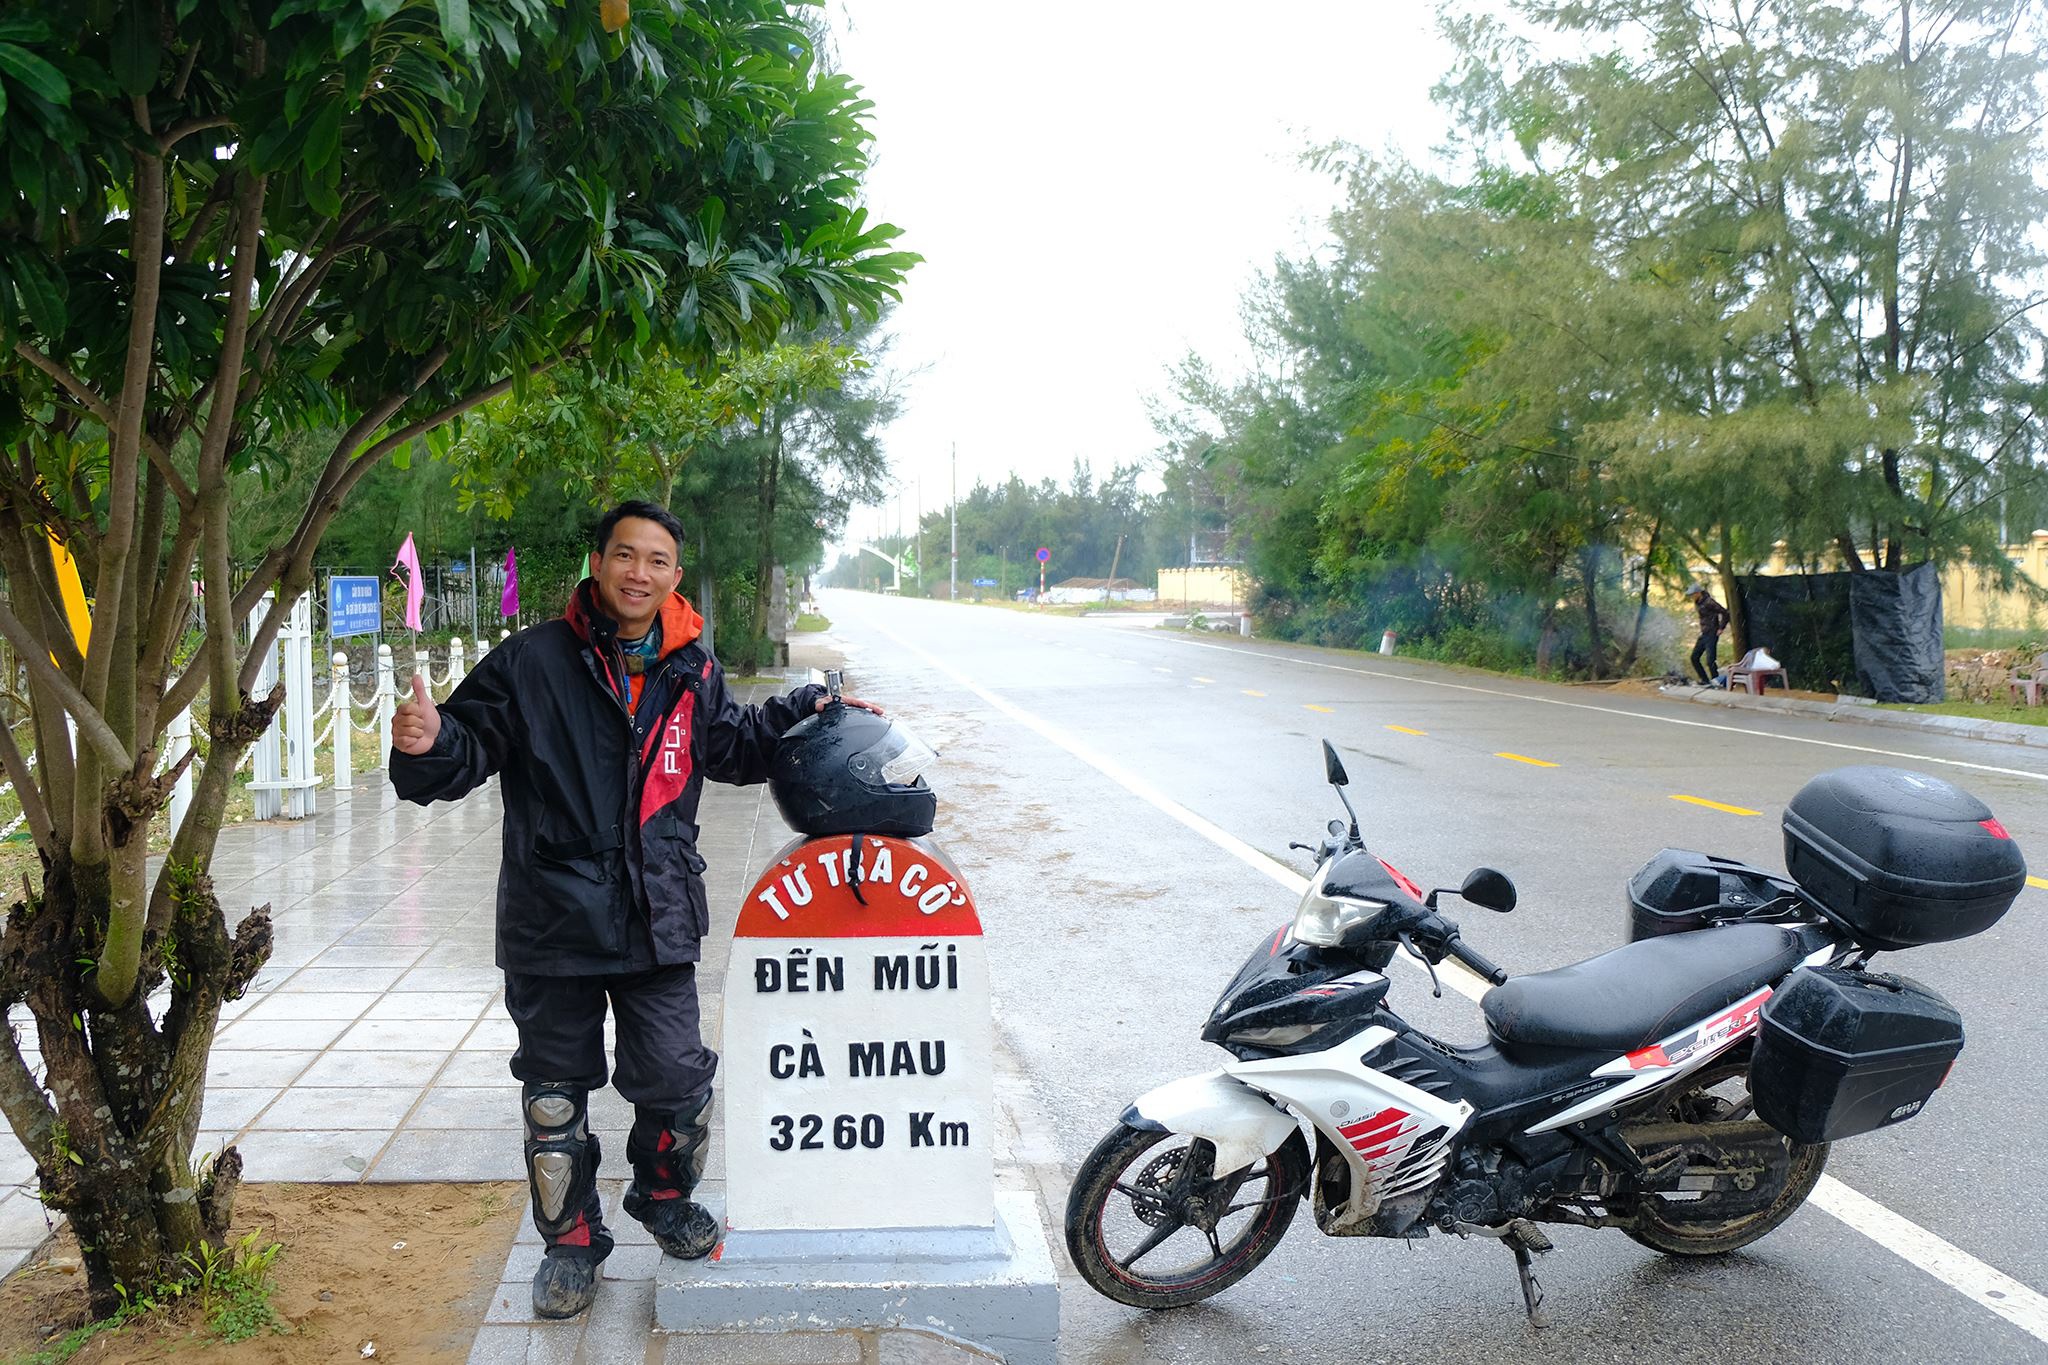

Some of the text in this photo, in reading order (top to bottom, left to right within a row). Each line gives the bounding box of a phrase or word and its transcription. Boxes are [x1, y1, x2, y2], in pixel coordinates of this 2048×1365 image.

[758, 858, 813, 921] TỪ
[754, 948, 844, 993] ĐẾN
[769, 1028, 946, 1079] CÀ MAU
[769, 1112, 969, 1151] 3260 Km
